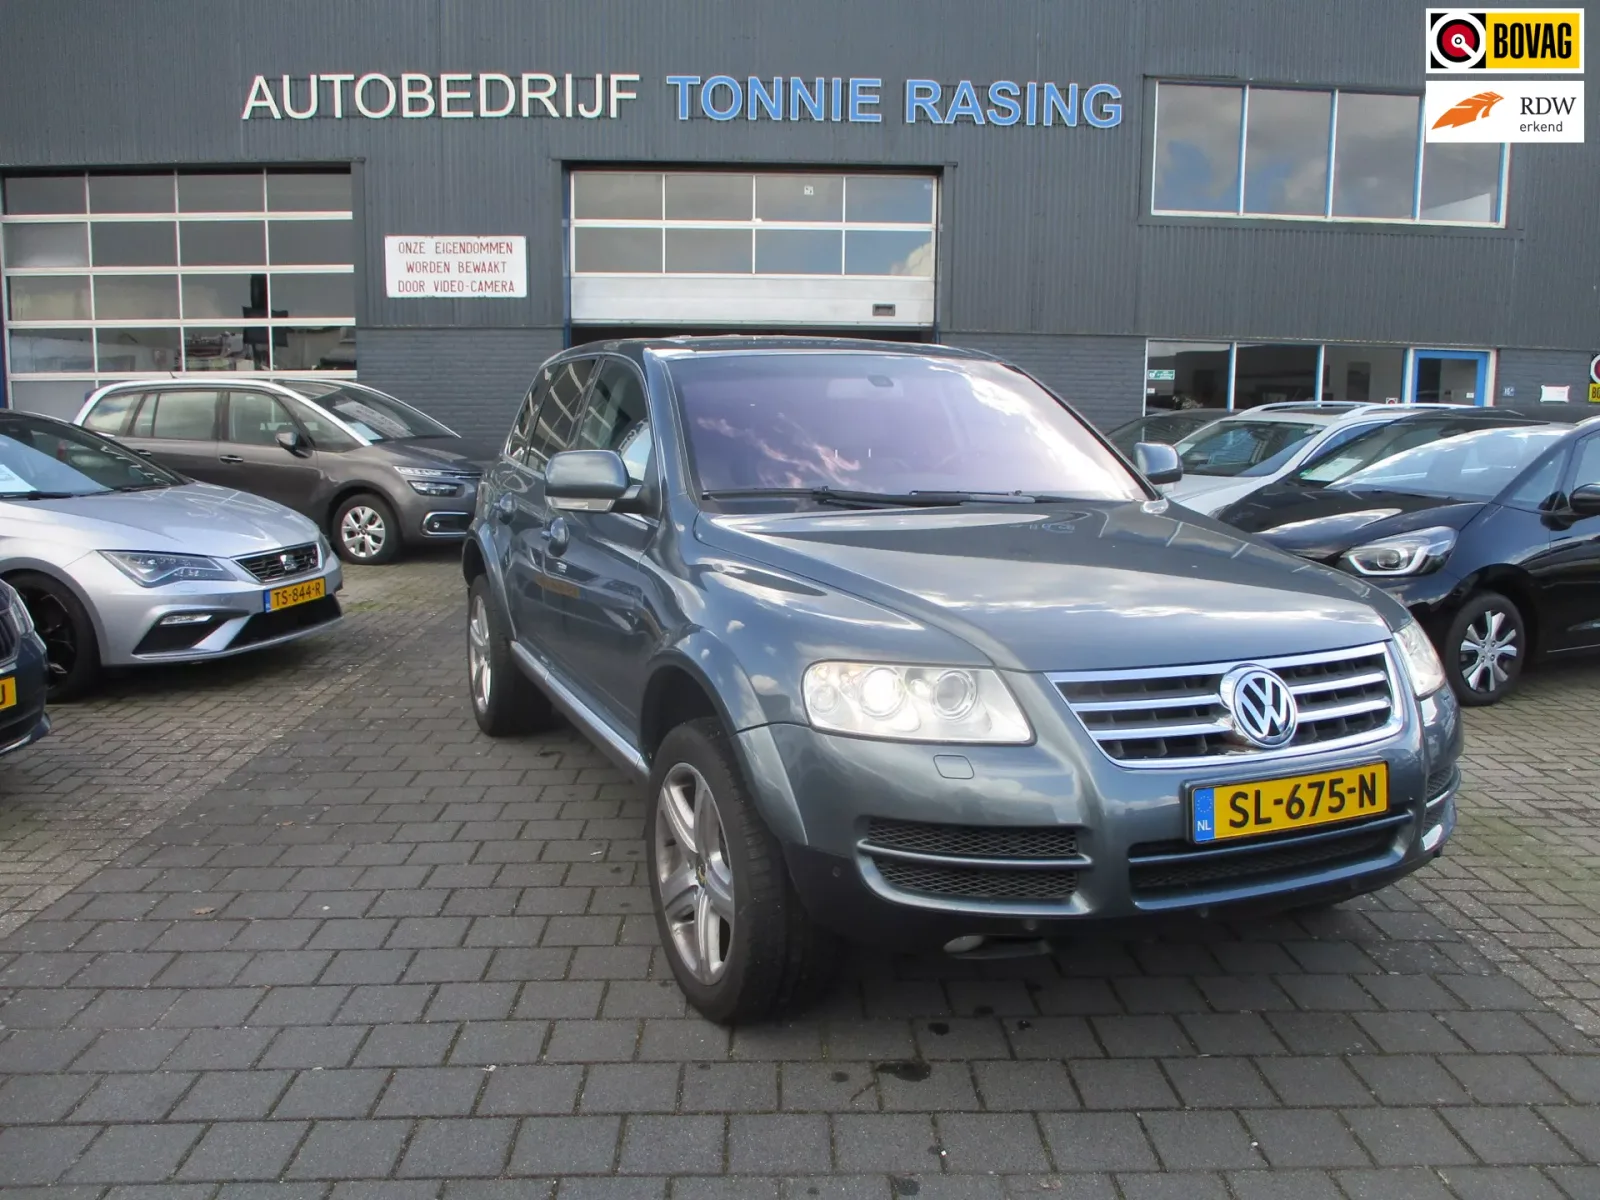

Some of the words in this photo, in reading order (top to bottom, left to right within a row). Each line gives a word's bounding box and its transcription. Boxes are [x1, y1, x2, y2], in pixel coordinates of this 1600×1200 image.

[241, 73, 640, 120] AUTOBEDRIJF
[666, 75, 882, 122] TONNIE
[905, 79, 1122, 128] RASING
[398, 241, 426, 254] ONZE
[435, 241, 513, 254] EIGENDOMMEN
[406, 261, 450, 273] WORDEN
[458, 261, 507, 273] BEWAAKT
[398, 280, 426, 292] DOOR
[433, 280, 515, 292] VIDEO-CAMERA
[274, 582, 321, 606] TS-844-R
[1229, 772, 1376, 829] SL-675-N
[1197, 820, 1211, 831] NL
